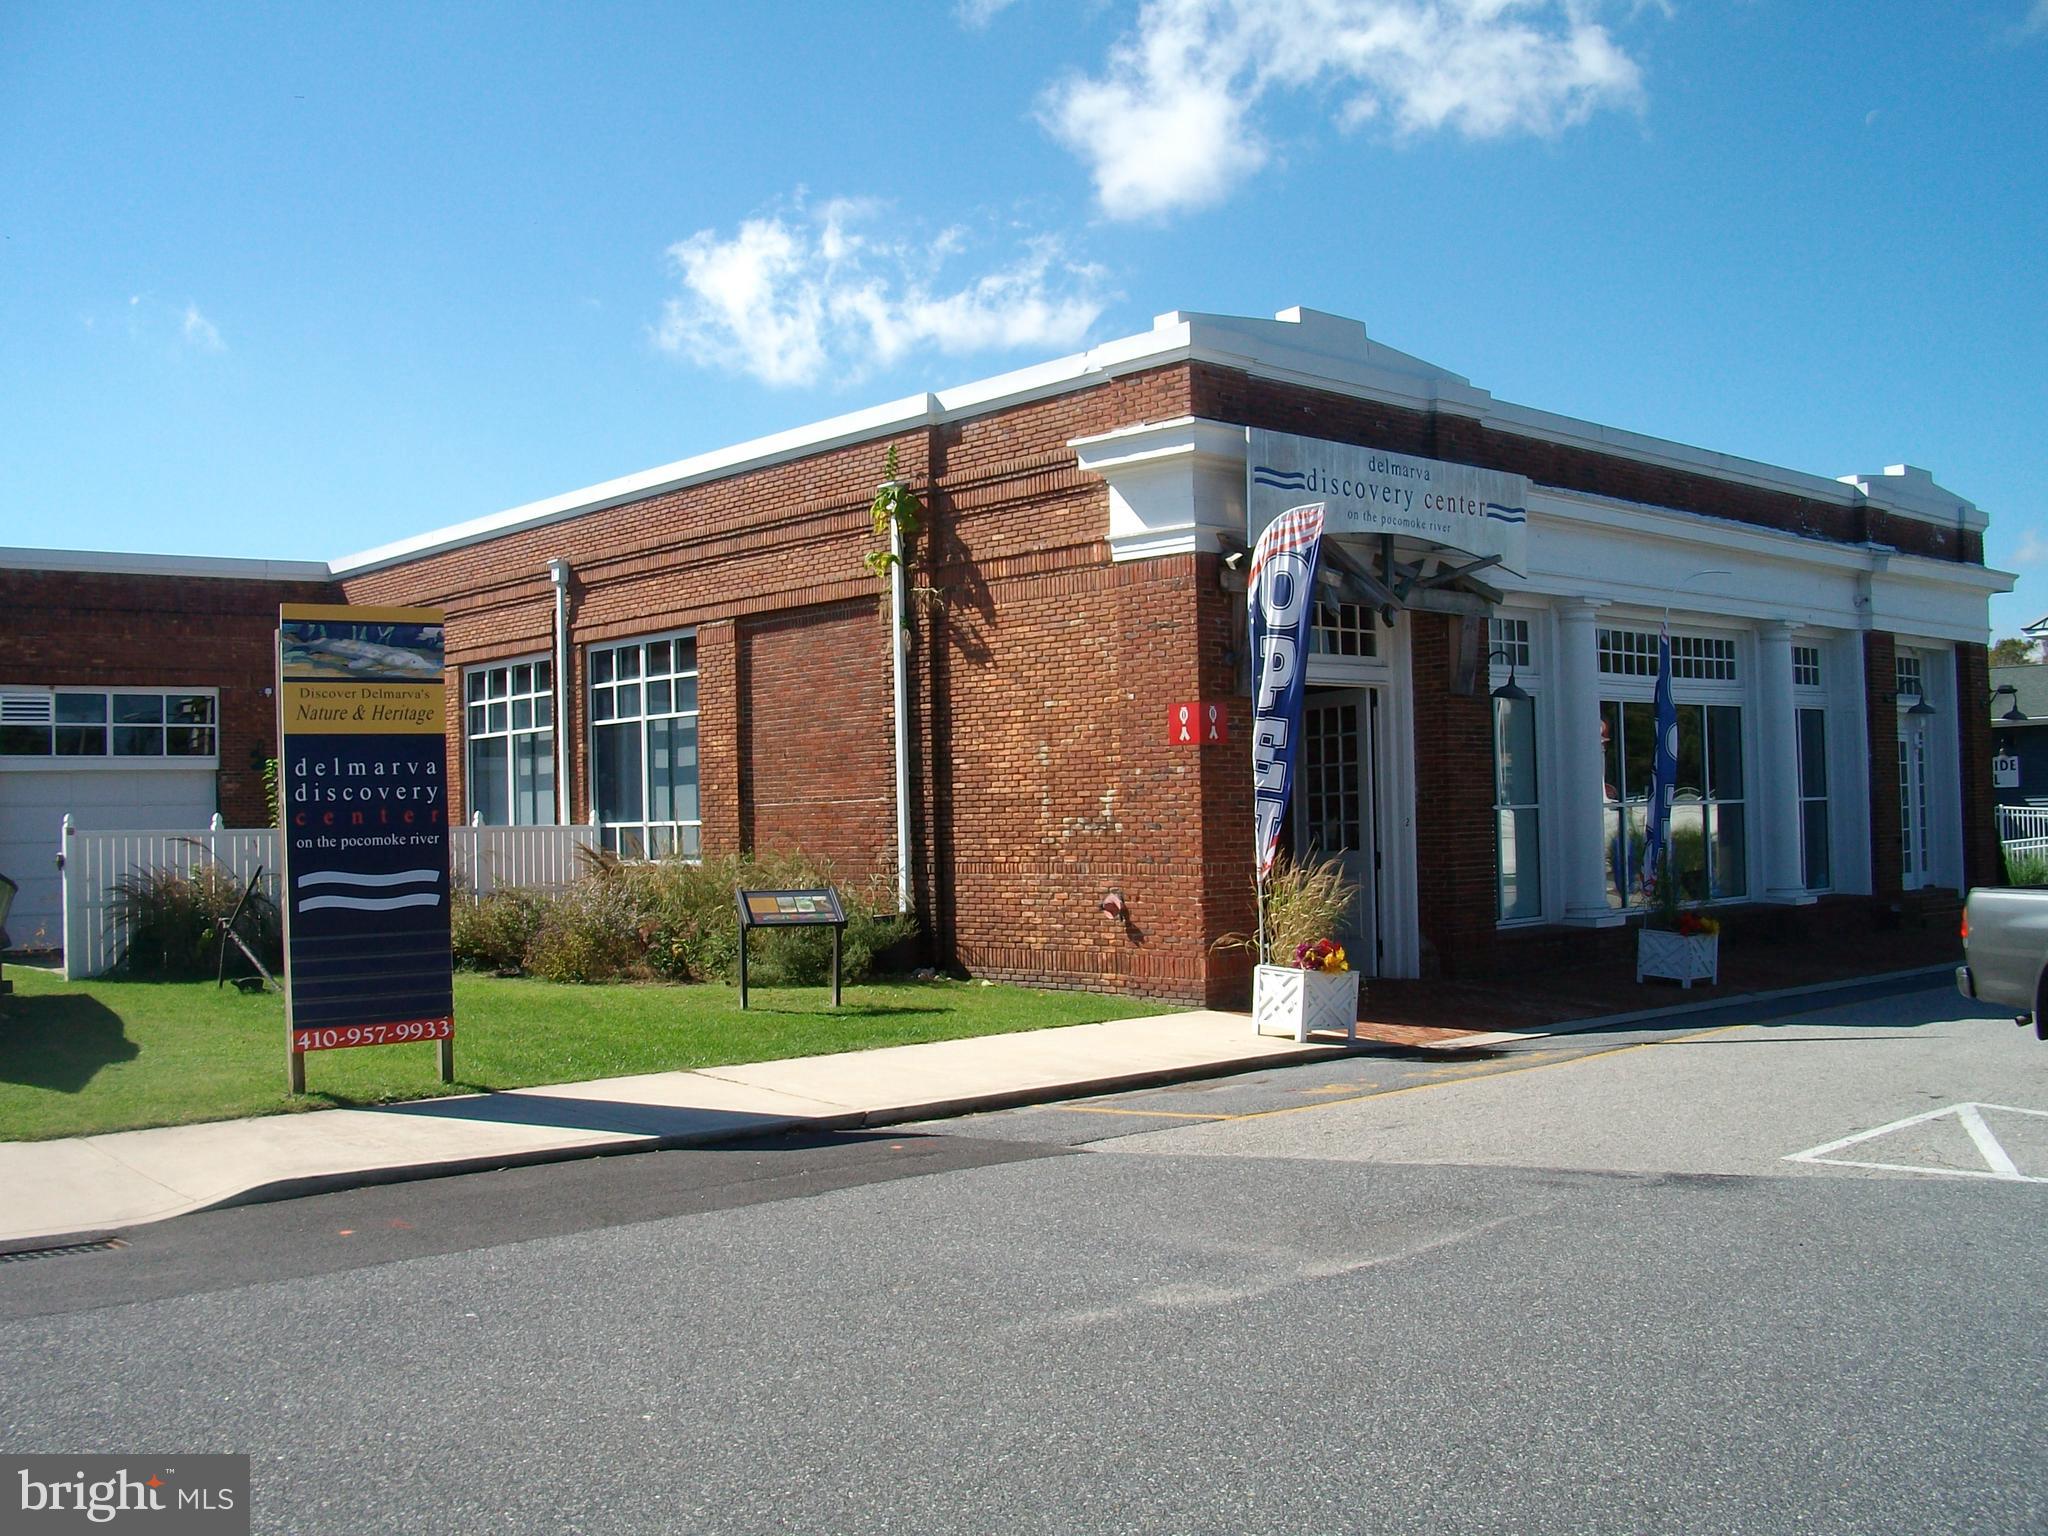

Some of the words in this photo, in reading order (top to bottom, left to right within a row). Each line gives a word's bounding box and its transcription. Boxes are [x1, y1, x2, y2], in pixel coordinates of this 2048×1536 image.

[1368, 455, 1431, 481] delmarva
[1306, 467, 1414, 512] discovery
[1424, 493, 1486, 517] center
[1347, 510, 1359, 520] on
[1363, 510, 1377, 523] the
[1381, 515, 1426, 532] pocomoke
[1429, 522, 1451, 533] river
[299, 687, 357, 699] Discover
[361, 687, 431, 699] Delmarva's
[296, 704, 348, 721] Nature
[352, 704, 366, 721] &
[372, 704, 434, 725] Heritage
[295, 757, 437, 776] delmarva
[295, 782, 438, 804] discovery
[295, 807, 439, 826] center
[296, 838, 313, 849] on
[317, 835, 337, 848] the
[341, 832, 407, 850] pocomoke
[410, 831, 440, 845] river
[297, 1020, 450, 1050] 410-957-9933
